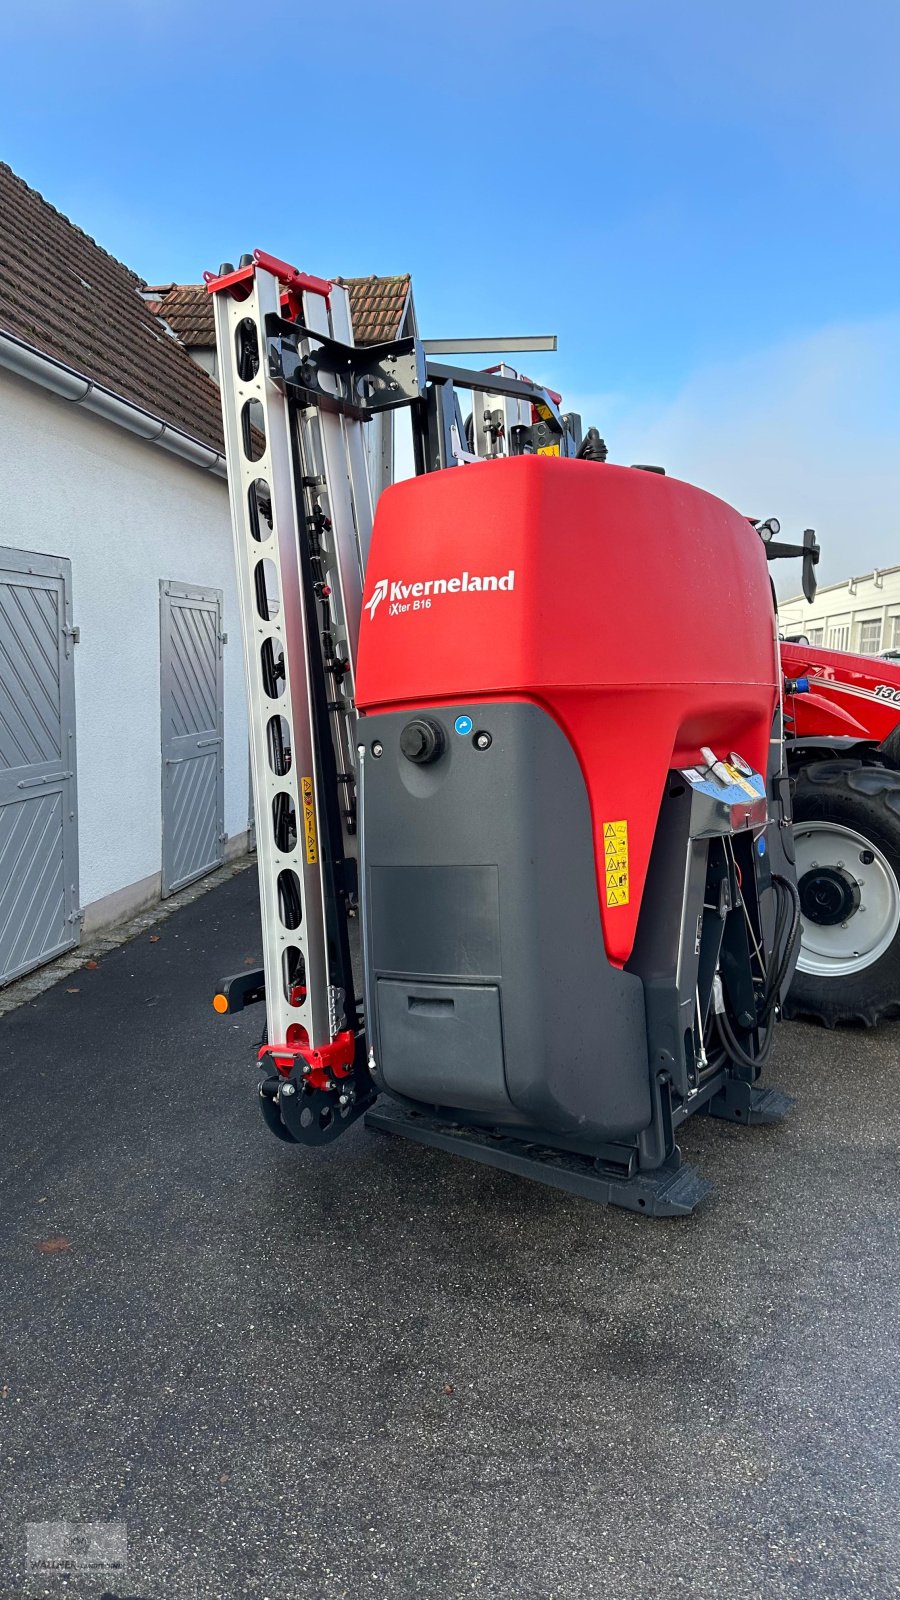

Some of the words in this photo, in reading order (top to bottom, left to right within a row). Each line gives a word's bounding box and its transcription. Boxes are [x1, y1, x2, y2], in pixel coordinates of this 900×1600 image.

[389, 570, 515, 601] Kverneland
[388, 603, 411, 616] iXter
[412, 598, 432, 611] B16
